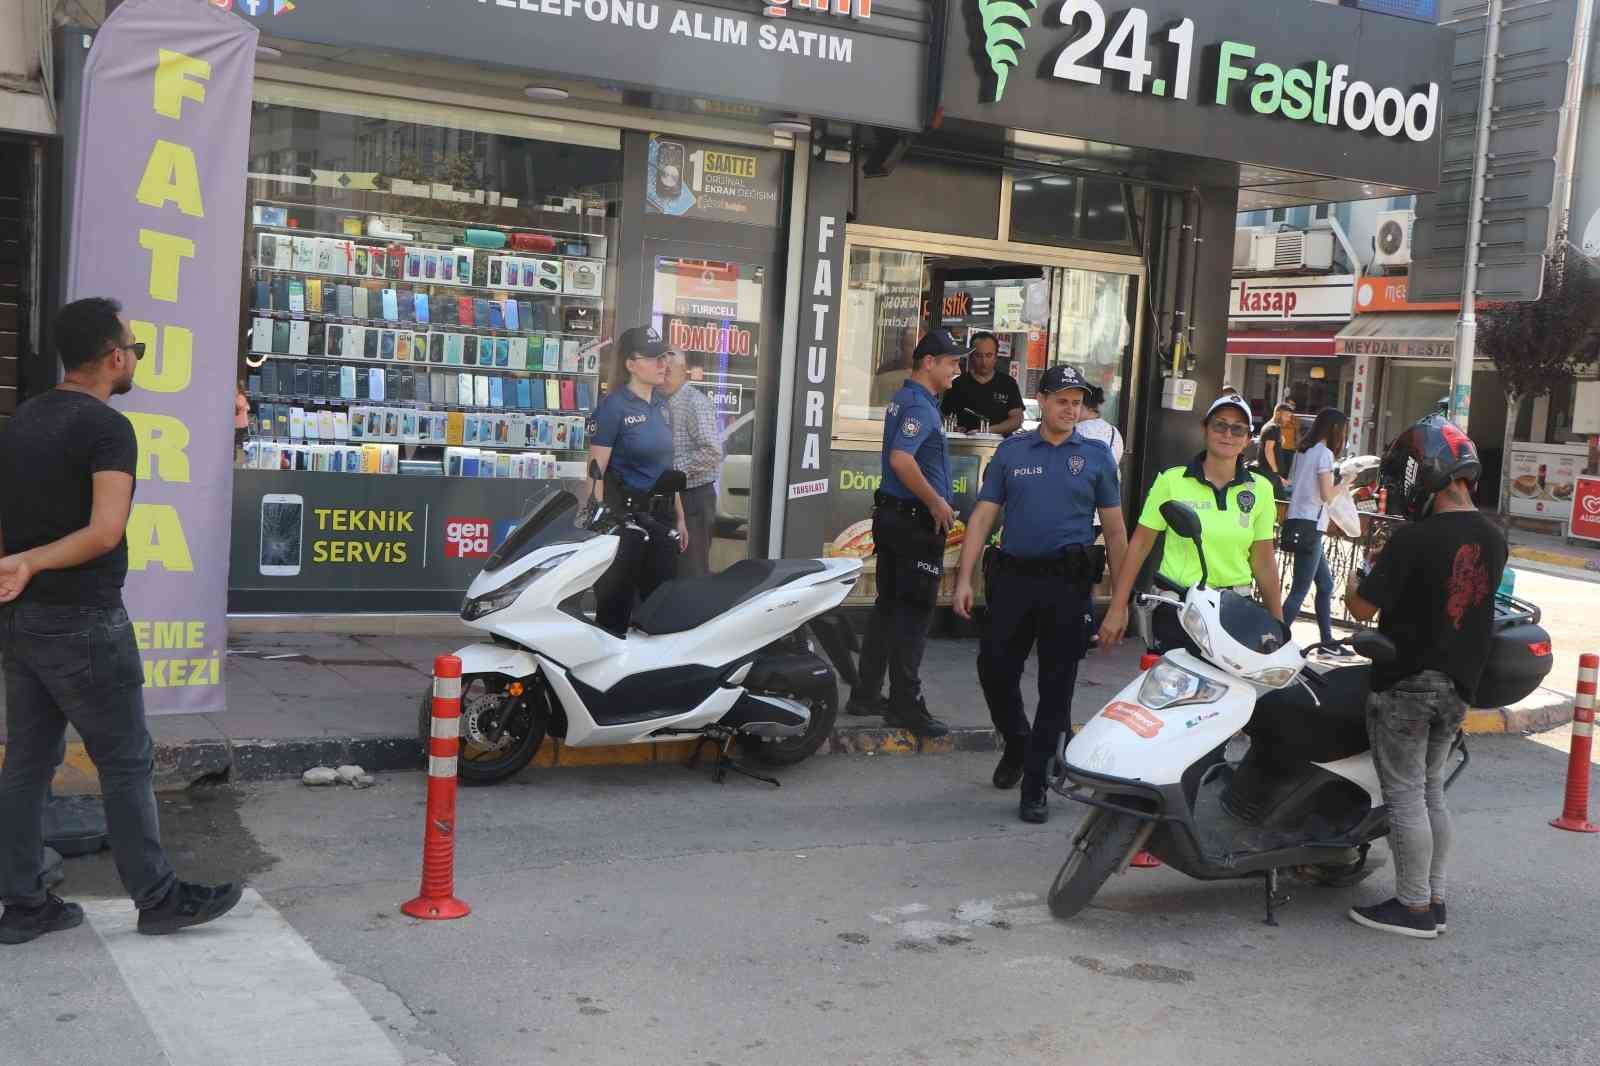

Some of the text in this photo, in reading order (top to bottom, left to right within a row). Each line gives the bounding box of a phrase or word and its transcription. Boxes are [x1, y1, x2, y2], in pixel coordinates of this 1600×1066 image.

[670, 10, 748, 46] ALIM
[758, 25, 853, 63] SATIM
[1053, 0, 1439, 142] 24.1 Fastfood
[689, 149, 754, 191] 1 SAATTE
[705, 184, 736, 197] EKRAN
[128, 49, 211, 572] FATURA
[691, 304, 737, 317] TURKCELL
[1240, 281, 1297, 318] kasap
[801, 216, 835, 470] FATURA
[1344, 340, 1396, 354] MEYDAN
[447, 522, 489, 542] gen
[458, 539, 488, 558] pa
